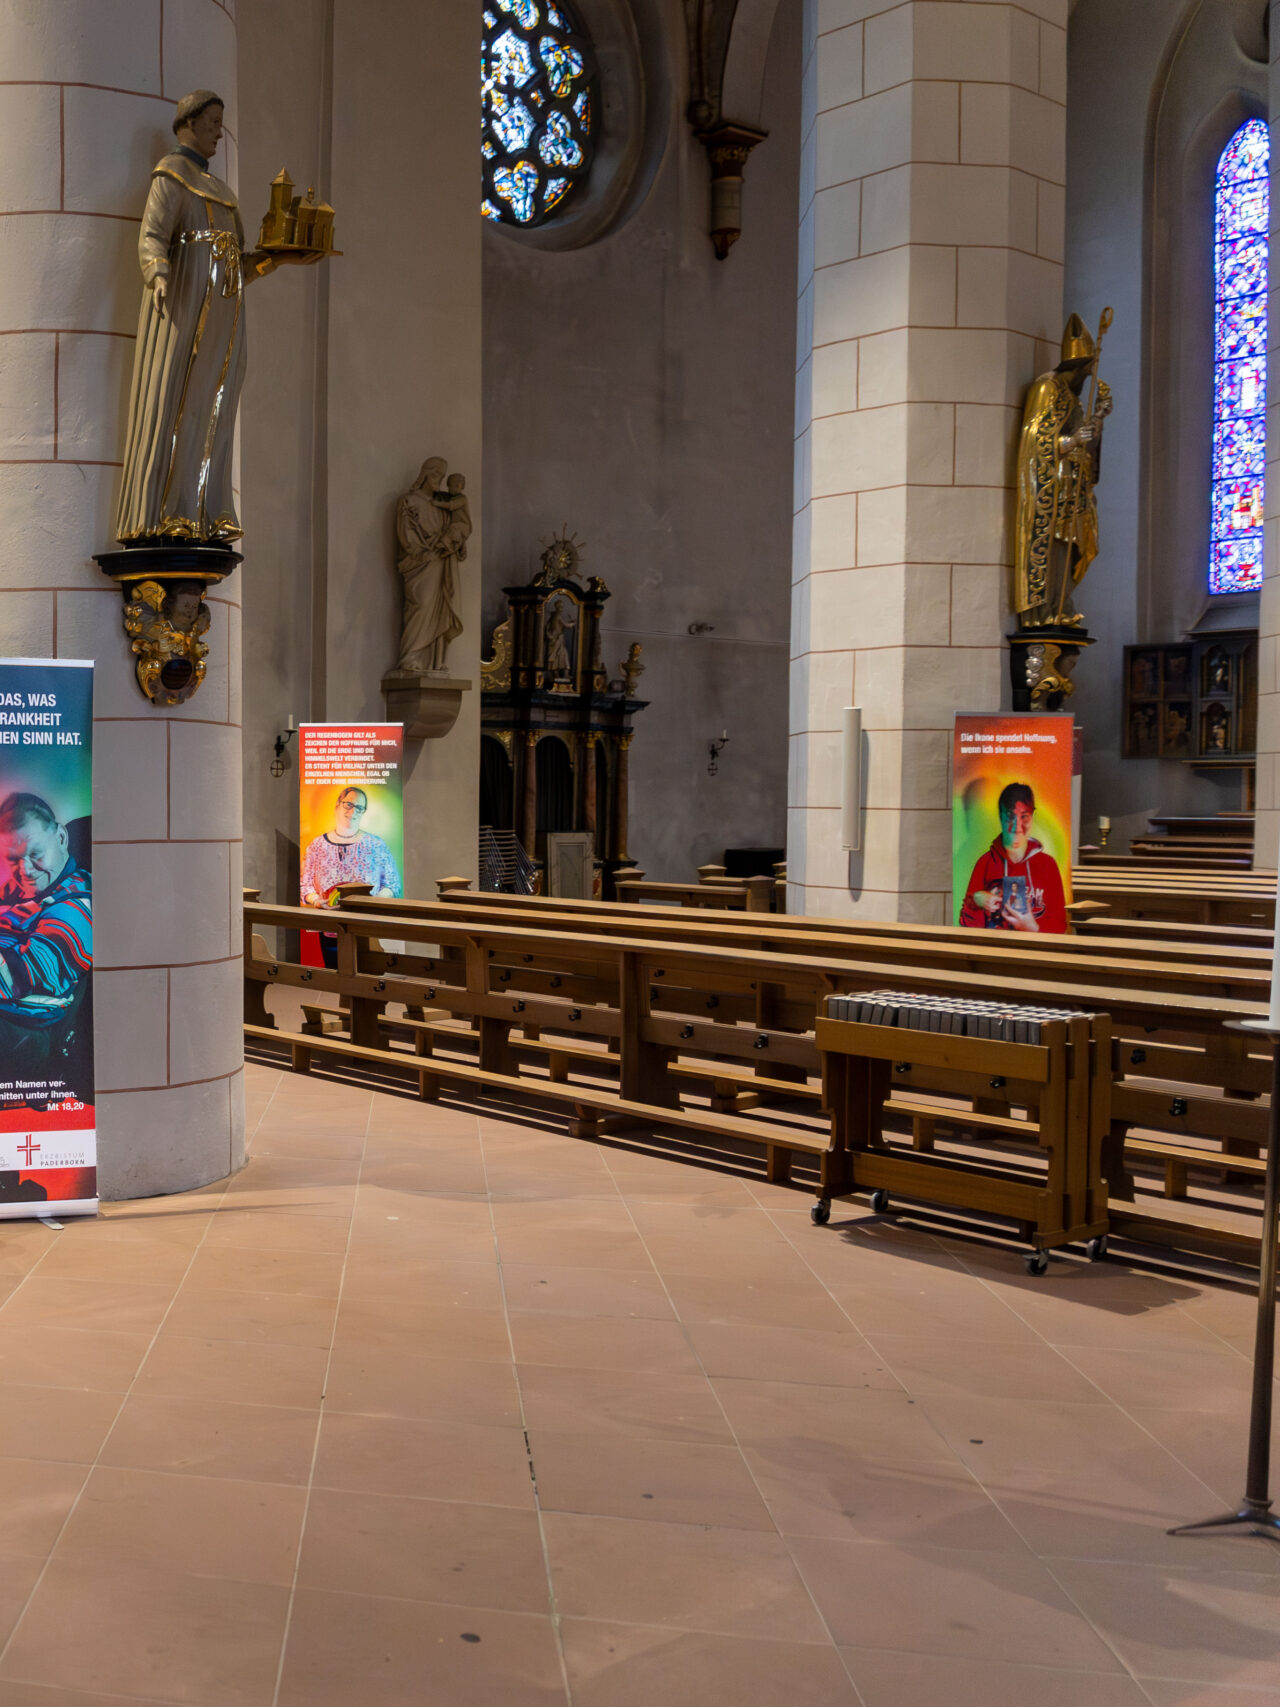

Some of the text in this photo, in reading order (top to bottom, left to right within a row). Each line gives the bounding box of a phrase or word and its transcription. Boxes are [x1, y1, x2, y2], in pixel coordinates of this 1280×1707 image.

[27, 694, 56, 707] WAS
[22, 732, 53, 745] SINN
[56, 732, 82, 746] HAT.
[961, 733, 973, 742] Die
[15, 1080, 46, 1089] Namen
[26, 1092, 49, 1100] unter
[47, 1102, 84, 1112] Mt 18,20
